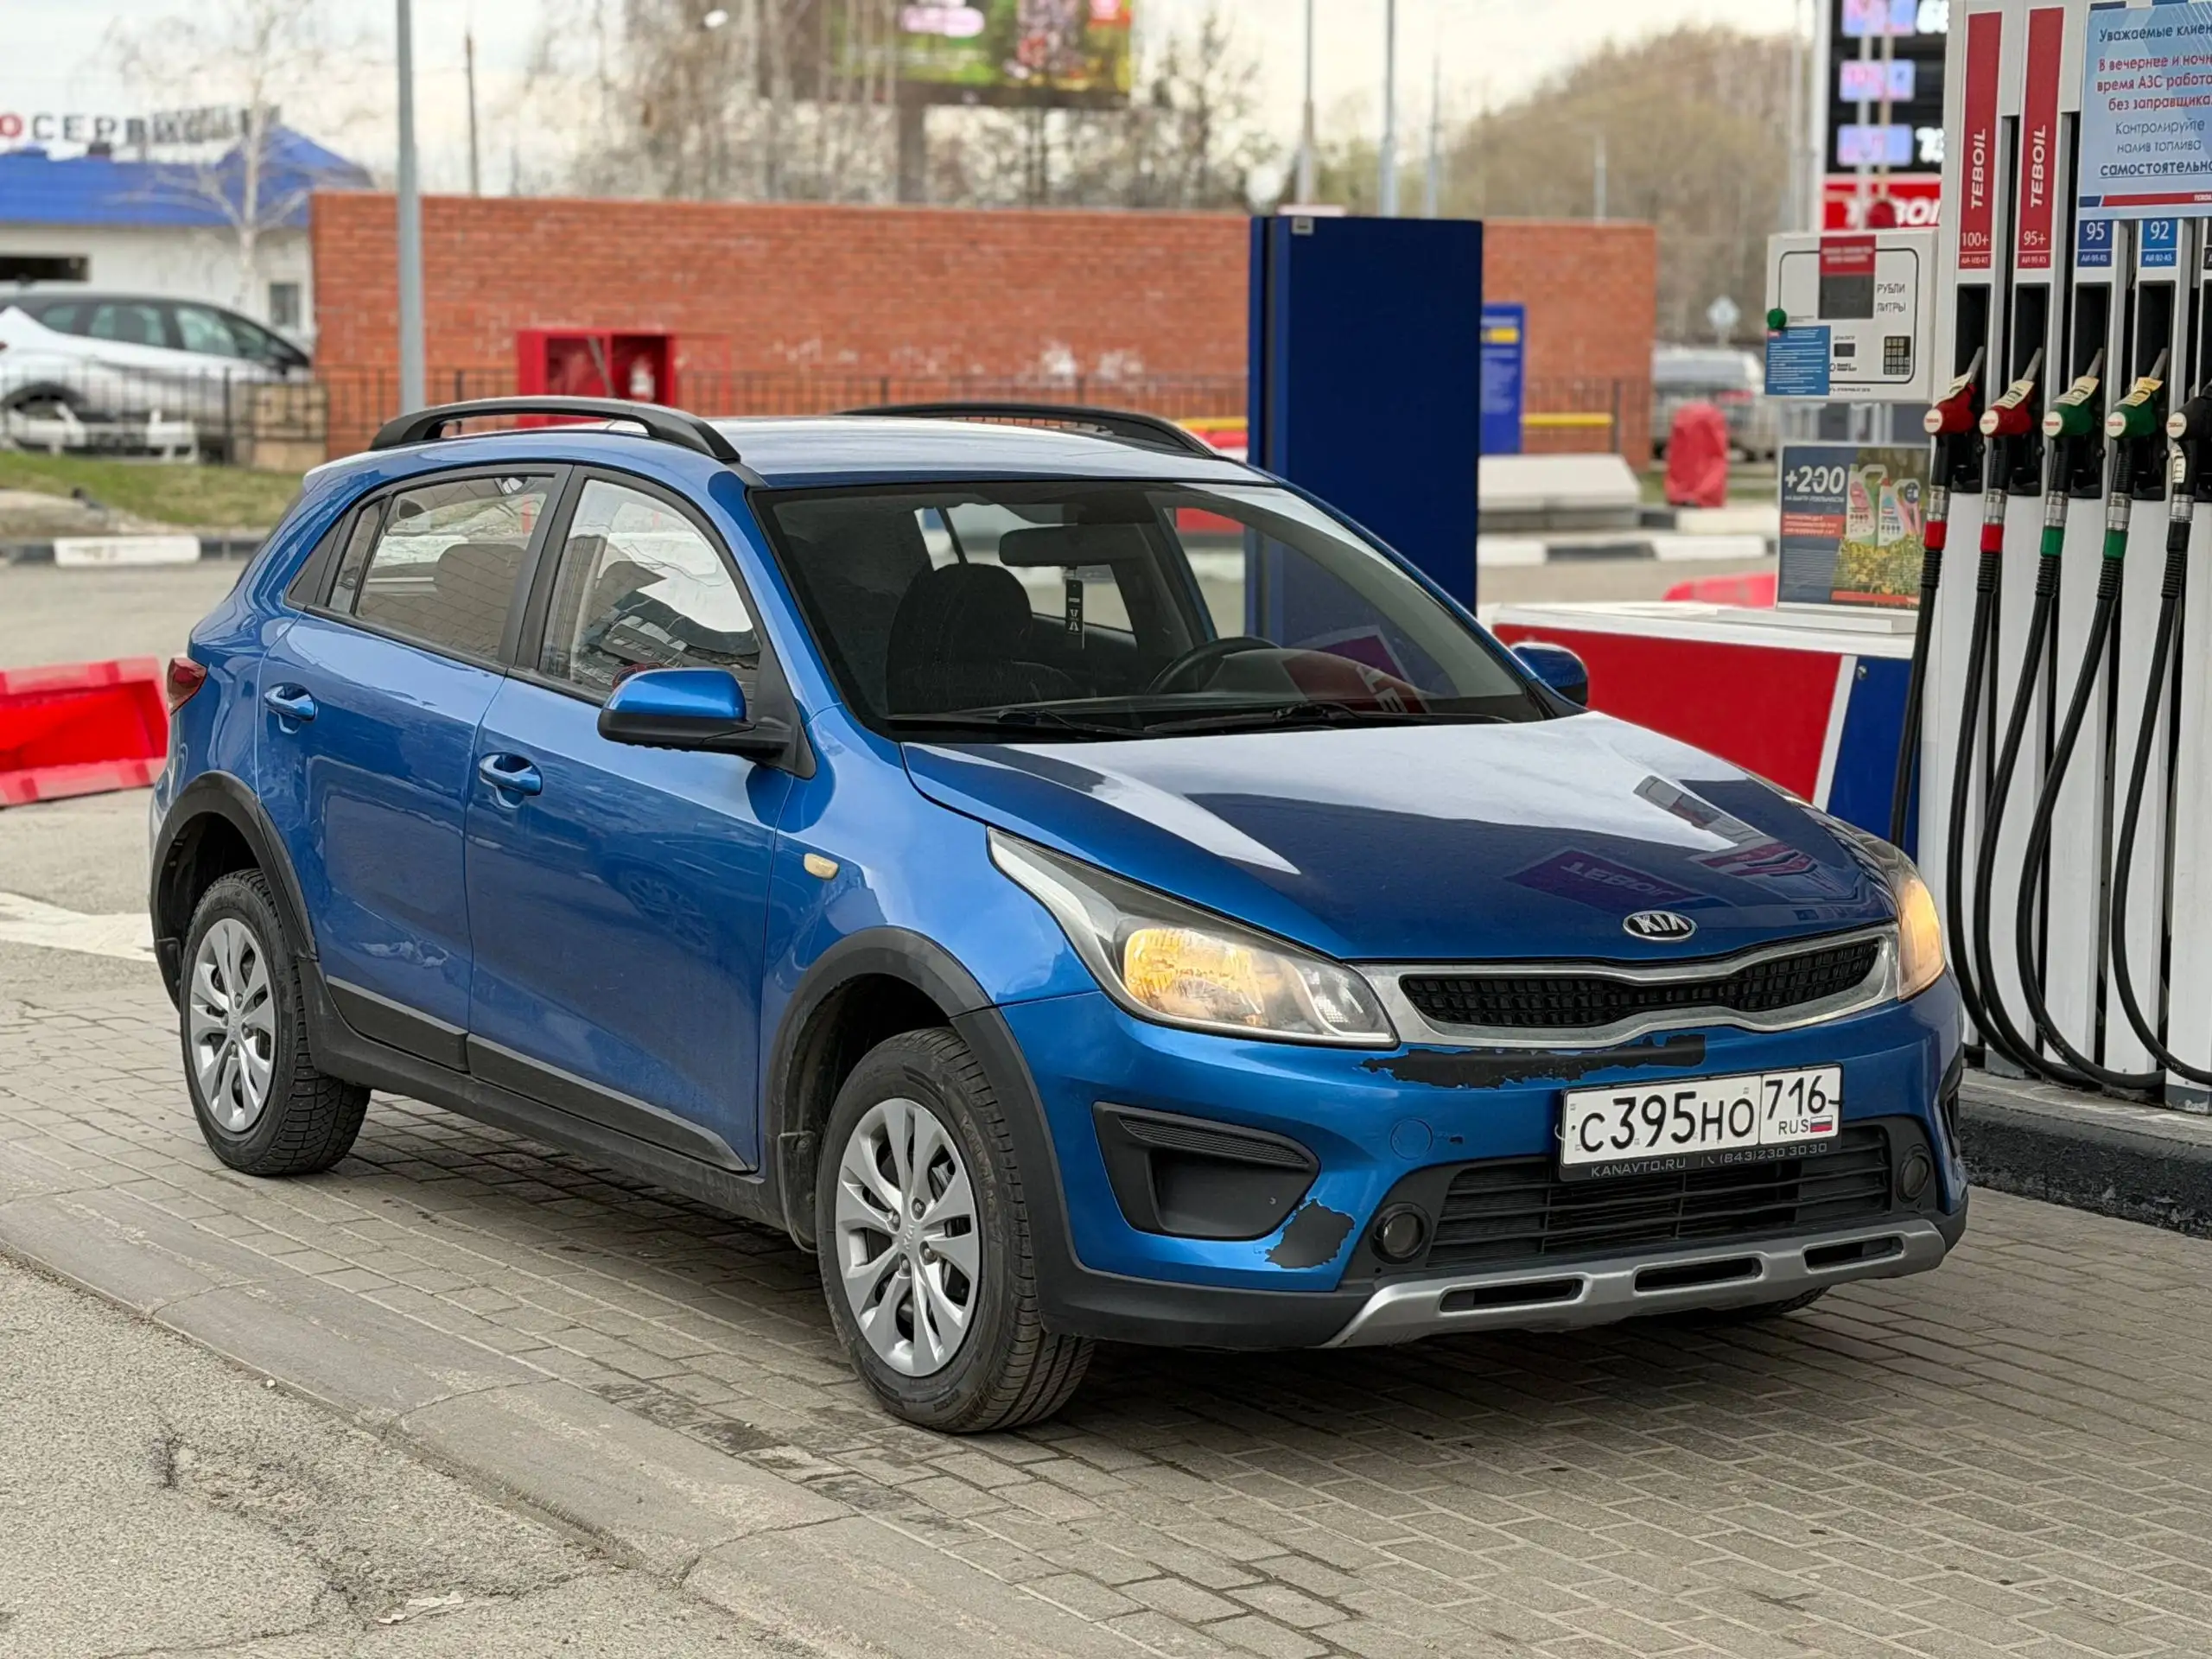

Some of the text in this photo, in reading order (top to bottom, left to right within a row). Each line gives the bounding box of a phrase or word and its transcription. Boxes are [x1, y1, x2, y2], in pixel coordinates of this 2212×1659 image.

[2099, 27, 2173, 42] Уважаемые
[2099, 58, 2106, 72] В
[2109, 57, 2168, 72] вечернее
[2171, 55, 2179, 67] и
[2097, 79, 2134, 94] время
[2138, 75, 2163, 89] АЗС
[2108, 97, 2130, 111] без
[2115, 117, 2205, 137] Контролируйте
[2117, 140, 2202, 154] налив топливо
[1971, 128, 1986, 210] TEBOIL
[2031, 124, 2046, 208] TEBOIL
[1961, 232, 1989, 247] 100+
[2023, 231, 2046, 246] 95+
[2086, 221, 2106, 241] 95
[2150, 220, 2170, 240] 92
[1877, 283, 1905, 295] РУБЛИ
[1876, 302, 1906, 314] ЛИТРЫ
[1784, 465, 1846, 494] +200
[1635, 913, 1689, 934] KIA
[1764, 1075, 1826, 1121] 716
[1777, 1122, 1808, 1135] RUS
[1591, 1157, 1685, 1178] KANAVTO.RU
